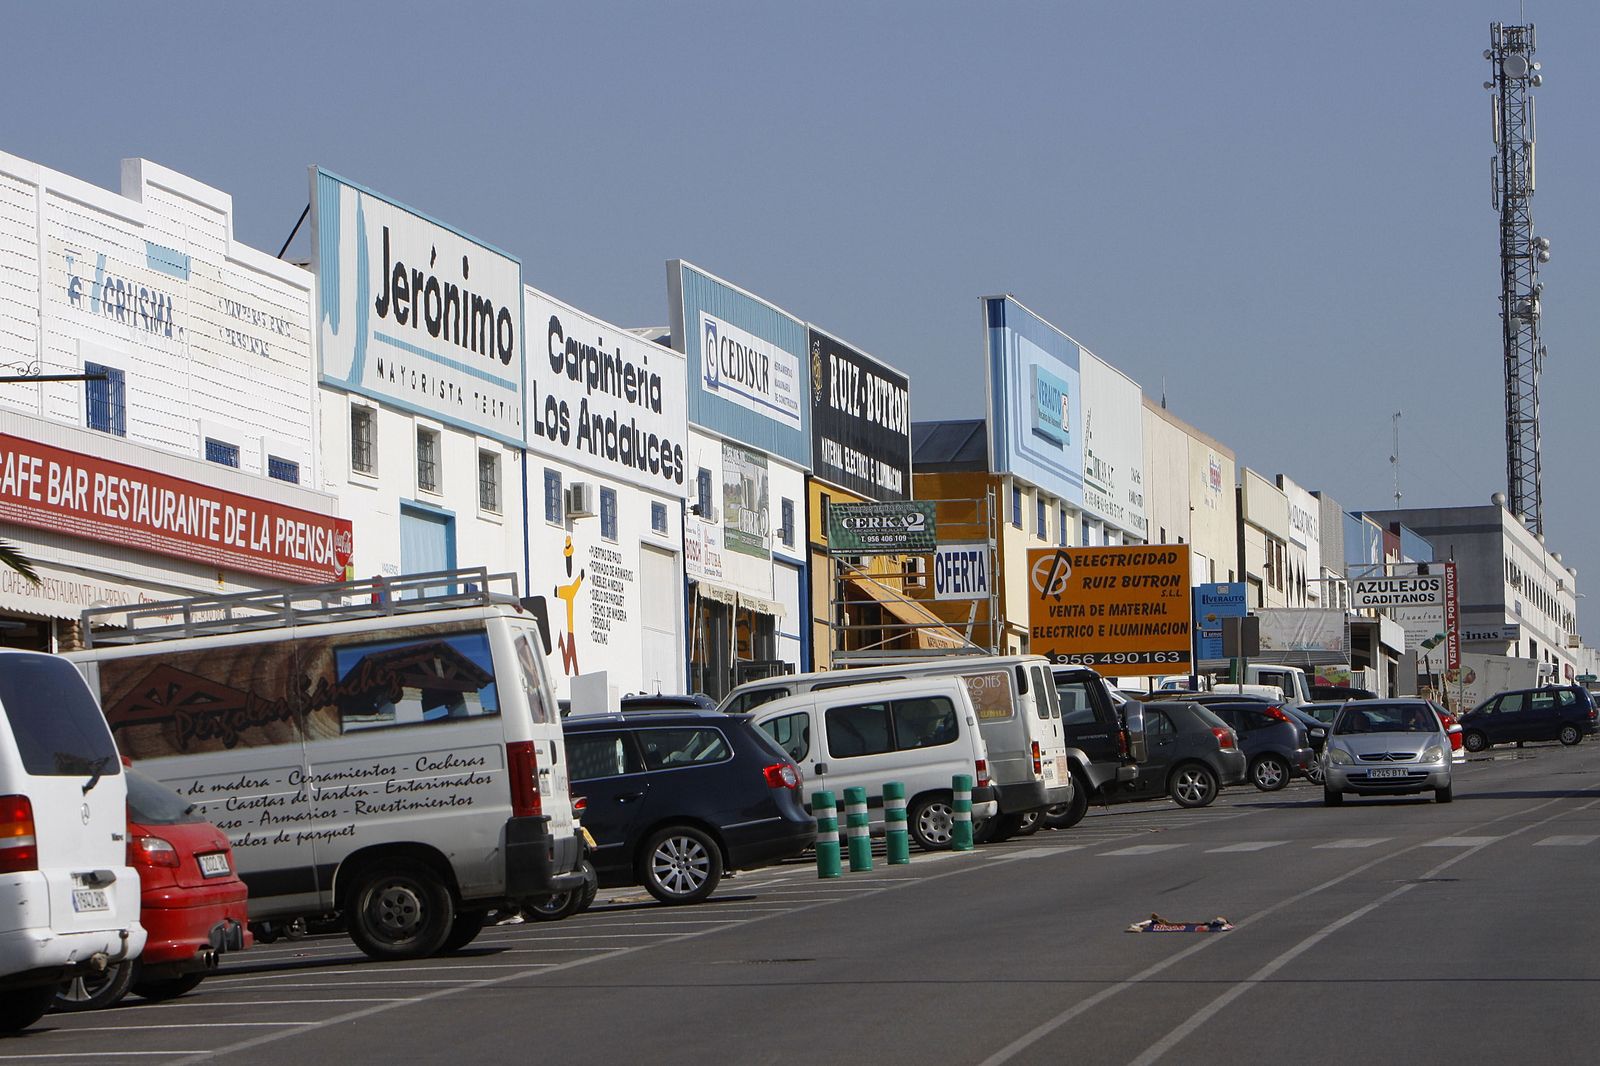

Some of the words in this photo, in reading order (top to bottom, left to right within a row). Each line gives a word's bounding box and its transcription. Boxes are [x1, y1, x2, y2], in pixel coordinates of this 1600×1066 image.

[375, 226, 514, 366] Jerónimo
[548, 314, 662, 415] Carpinteria
[720, 335, 770, 396] CEDISUR
[376, 357, 463, 406] MAYORISTA
[474, 392, 520, 426] TEXTIL
[829, 353, 860, 418] RUIZ
[533, 380, 571, 446] Los
[576, 397, 684, 486] Andaluces
[0, 451, 43, 502] AFE
[47, 461, 89, 512] BAR
[93, 472, 221, 542] RESTAURANTE
[223, 505, 247, 548] DE
[250, 511, 271, 553] LA
[275, 517, 335, 567] PRENSA
[935, 551, 987, 595] OFERTA
[1074, 552, 1178, 567] ELECTRICIDAD
[1082, 576, 1117, 590] RUIZ
[1121, 574, 1182, 589] BUTRON
[1355, 579, 1440, 595] AZULEJOS
[1362, 593, 1436, 605] GADITANOS
[1446, 566, 1455, 599] MAYOR
[1049, 605, 1085, 618] VENTA
[1090, 604, 1104, 617] DE
[1108, 602, 1168, 617] MATERIAL
[1033, 625, 1094, 639] ELECTRICO
[1099, 624, 1105, 637] E
[1108, 621, 1189, 638] ILUMINACION
[1056, 654, 1095, 666] 956
[1100, 651, 1181, 664] 490163
[1449, 635, 1457, 665] VENTA
[188, 780, 204, 796] de
[210, 776, 270, 792] madera
[288, 764, 397, 786] Cerramientos
[415, 753, 486, 773] Cocheras
[225, 794, 286, 812] Casetas
[291, 790, 308, 805] de
[385, 771, 492, 795] Entarimados
[214, 818, 243, 830] aso
[259, 809, 337, 827] Armarios
[354, 795, 474, 816] Revestimientos
[273, 829, 290, 845] de
[296, 824, 356, 846] parquet
